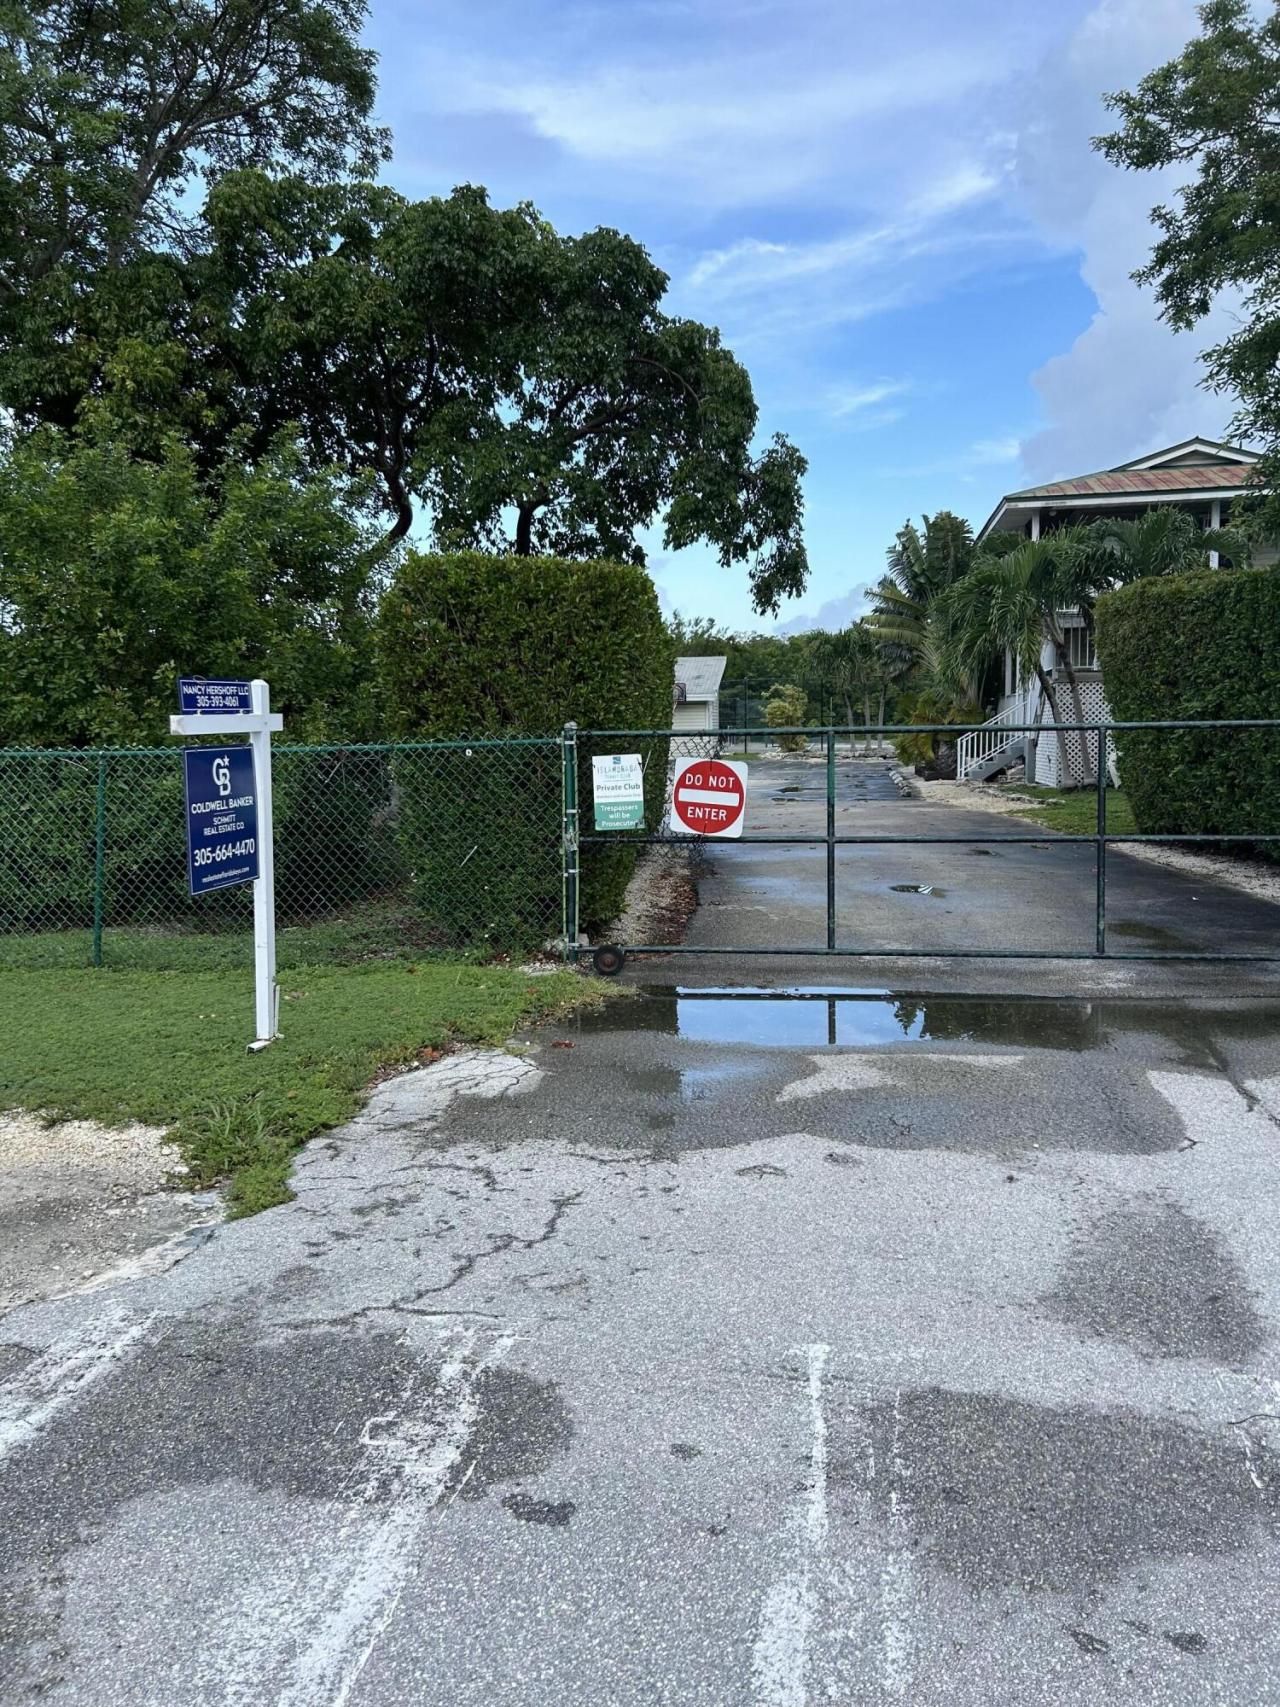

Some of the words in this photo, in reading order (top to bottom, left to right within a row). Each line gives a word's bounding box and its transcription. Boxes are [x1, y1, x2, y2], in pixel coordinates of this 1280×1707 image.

[183, 685, 205, 694] NANCY
[206, 686, 237, 695] HERSHOFF
[238, 687, 249, 695] LLC
[196, 696, 239, 707] 305-393-4061
[685, 773, 703, 786] DO
[708, 775, 735, 789] NOT
[191, 800, 228, 814] COLDWELL
[229, 796, 254, 808] BANKER
[600, 804, 638, 812] Trespassers
[213, 814, 236, 825] SCHMITT
[609, 811, 621, 819] will
[687, 806, 727, 821] ENTER
[203, 826, 218, 836] REAL
[218, 823, 236, 833] ESTATE
[194, 838, 255, 866] 305-664-4470
